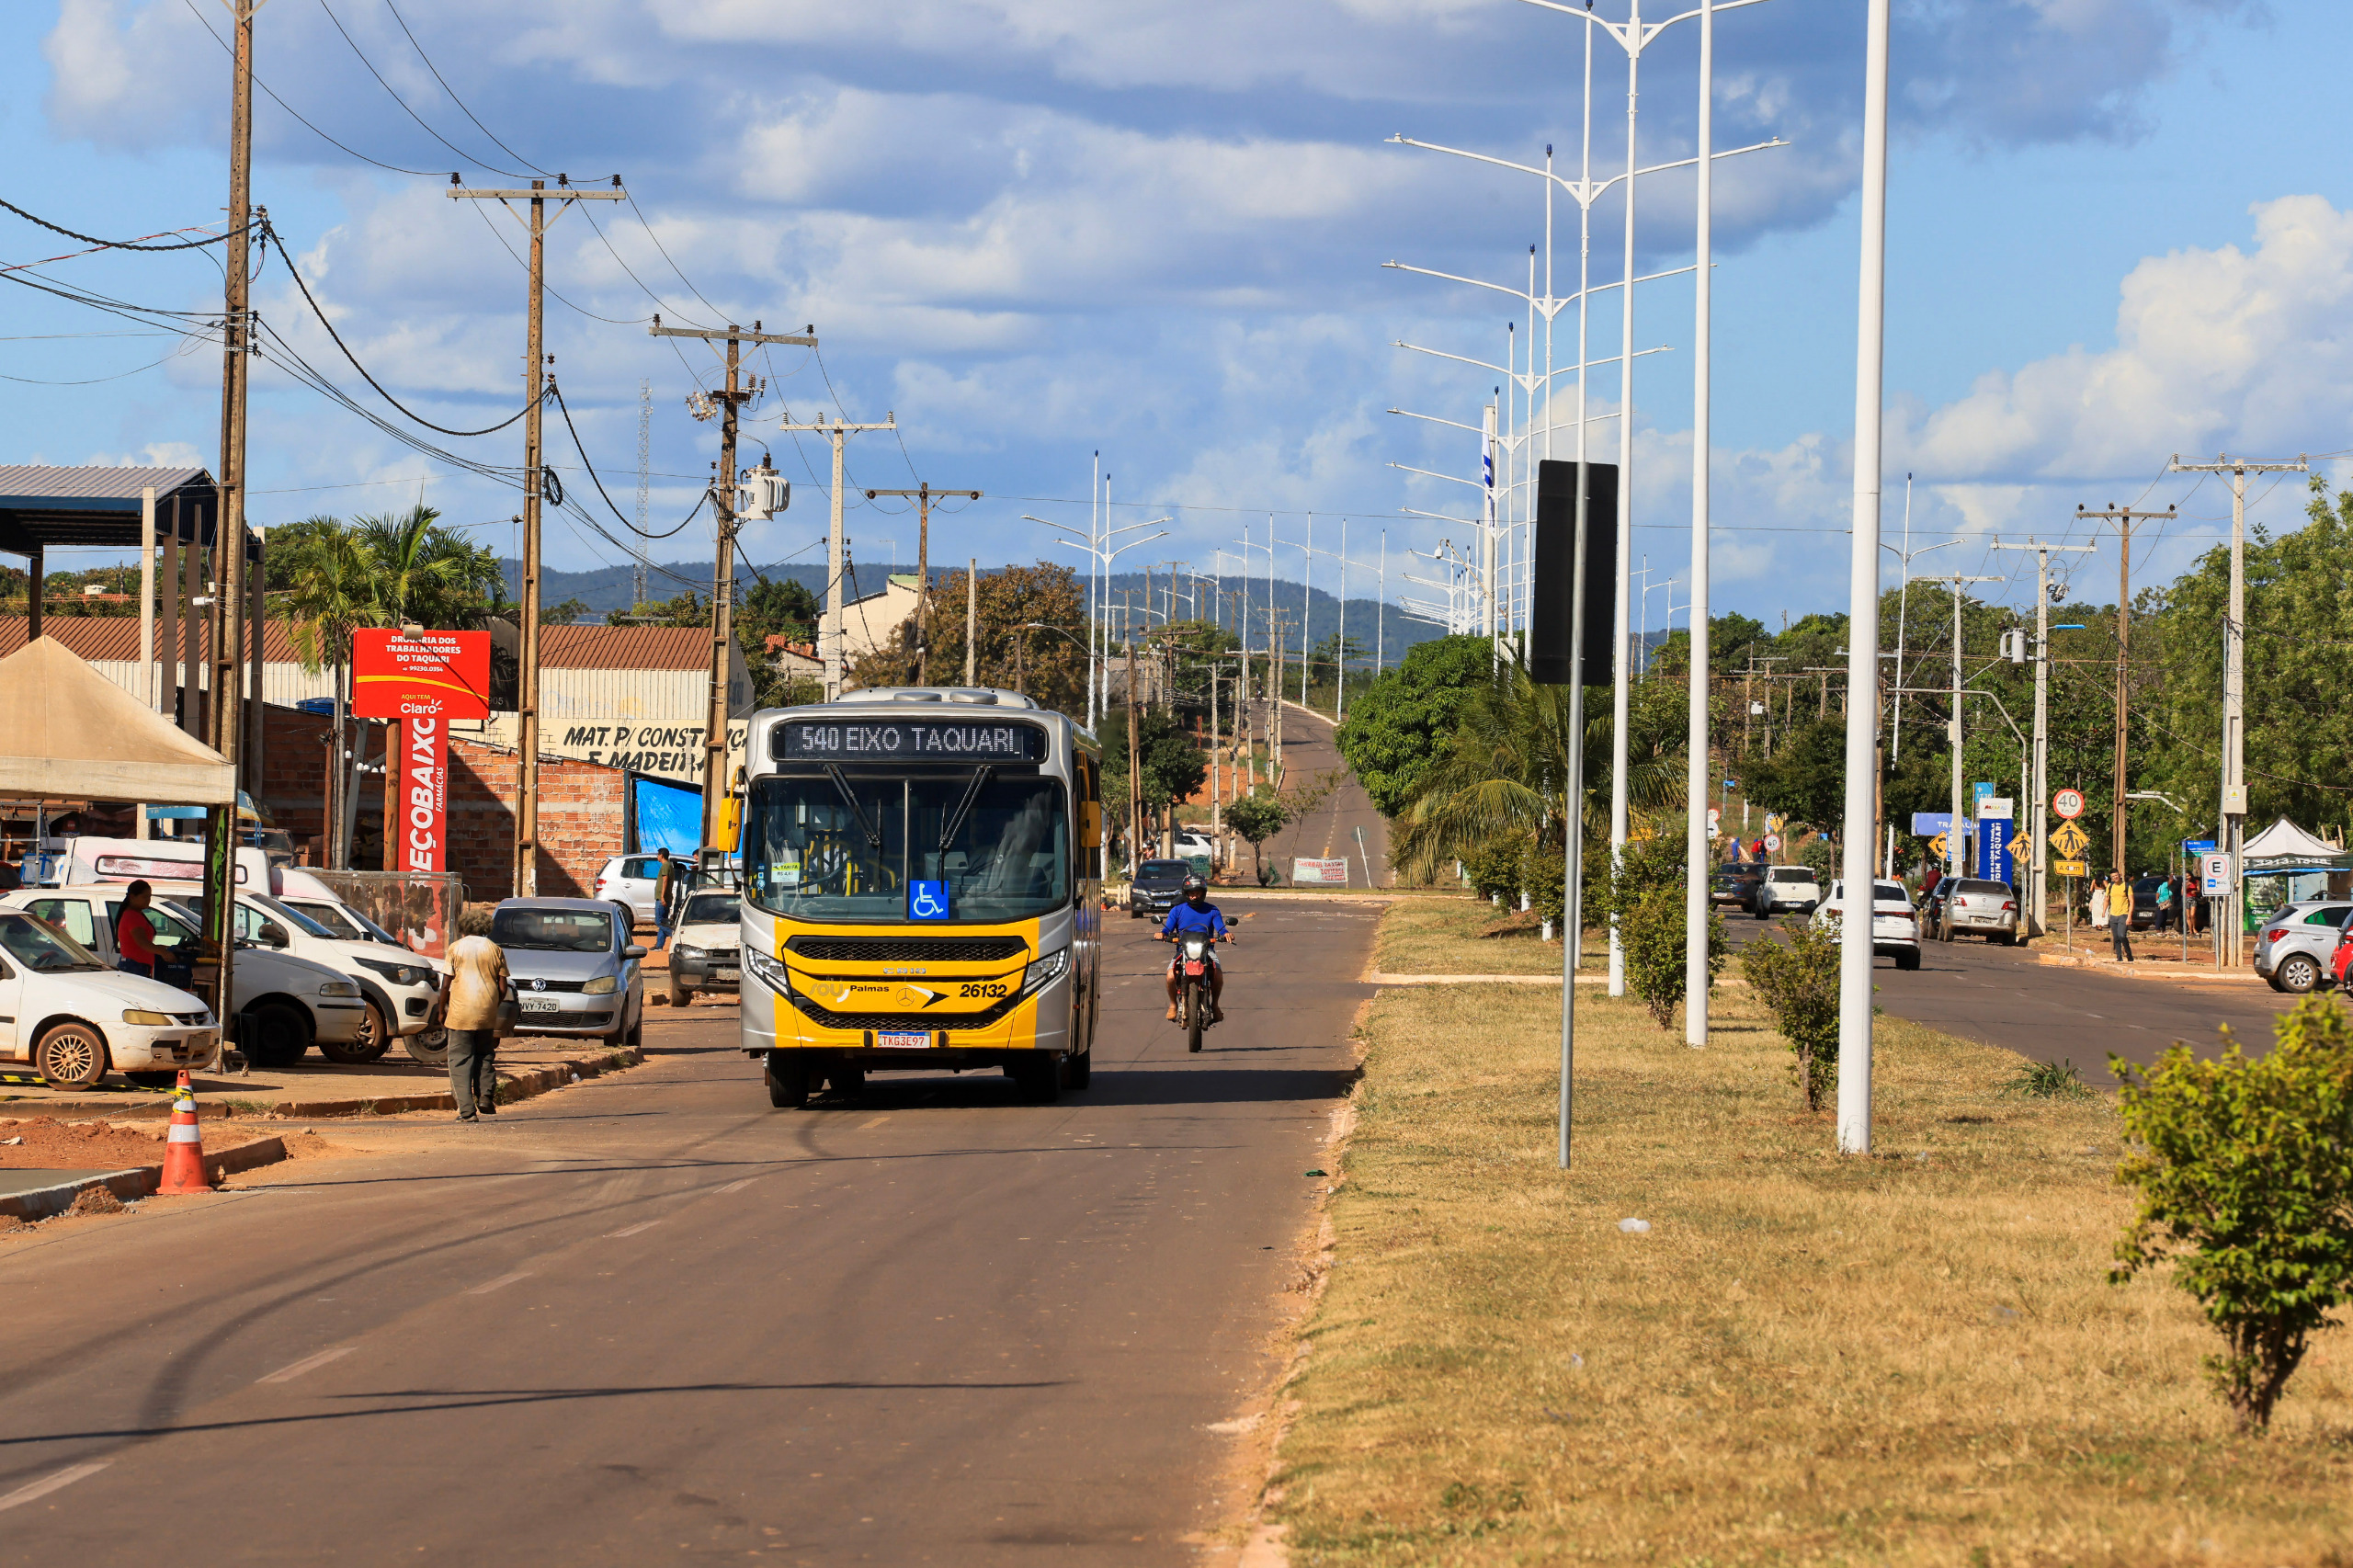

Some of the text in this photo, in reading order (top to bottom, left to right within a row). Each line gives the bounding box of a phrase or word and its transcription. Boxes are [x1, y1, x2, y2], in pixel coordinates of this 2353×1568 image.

[385, 644, 461, 654] TRABALHADORES
[411, 654, 449, 664] TAQUARI
[400, 701, 438, 715] Claro
[563, 726, 611, 747] MAT.
[801, 726, 839, 751] 540
[847, 727, 901, 751] EIXO
[435, 766, 444, 812] FARMÁCIAS
[2057, 794, 2078, 808] 40
[2211, 861, 2222, 873] E
[849, 984, 890, 993] Palmas
[959, 983, 1007, 998] 26132
[881, 1036, 925, 1047] TKG3E97
